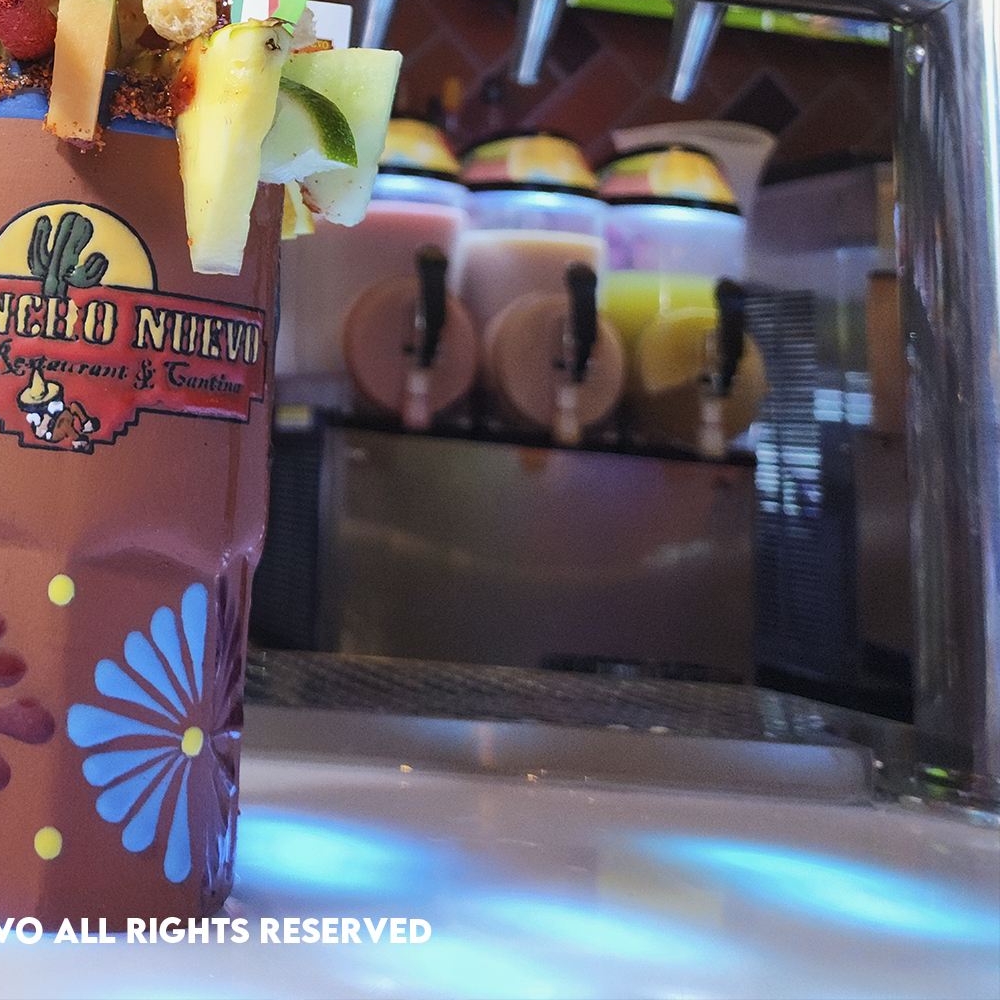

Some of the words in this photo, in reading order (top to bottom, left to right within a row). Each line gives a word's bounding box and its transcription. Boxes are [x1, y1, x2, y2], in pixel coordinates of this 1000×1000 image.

[131, 304, 261, 365] NUEVO
[133, 358, 156, 390] &
[163, 360, 242, 395] Cantina
